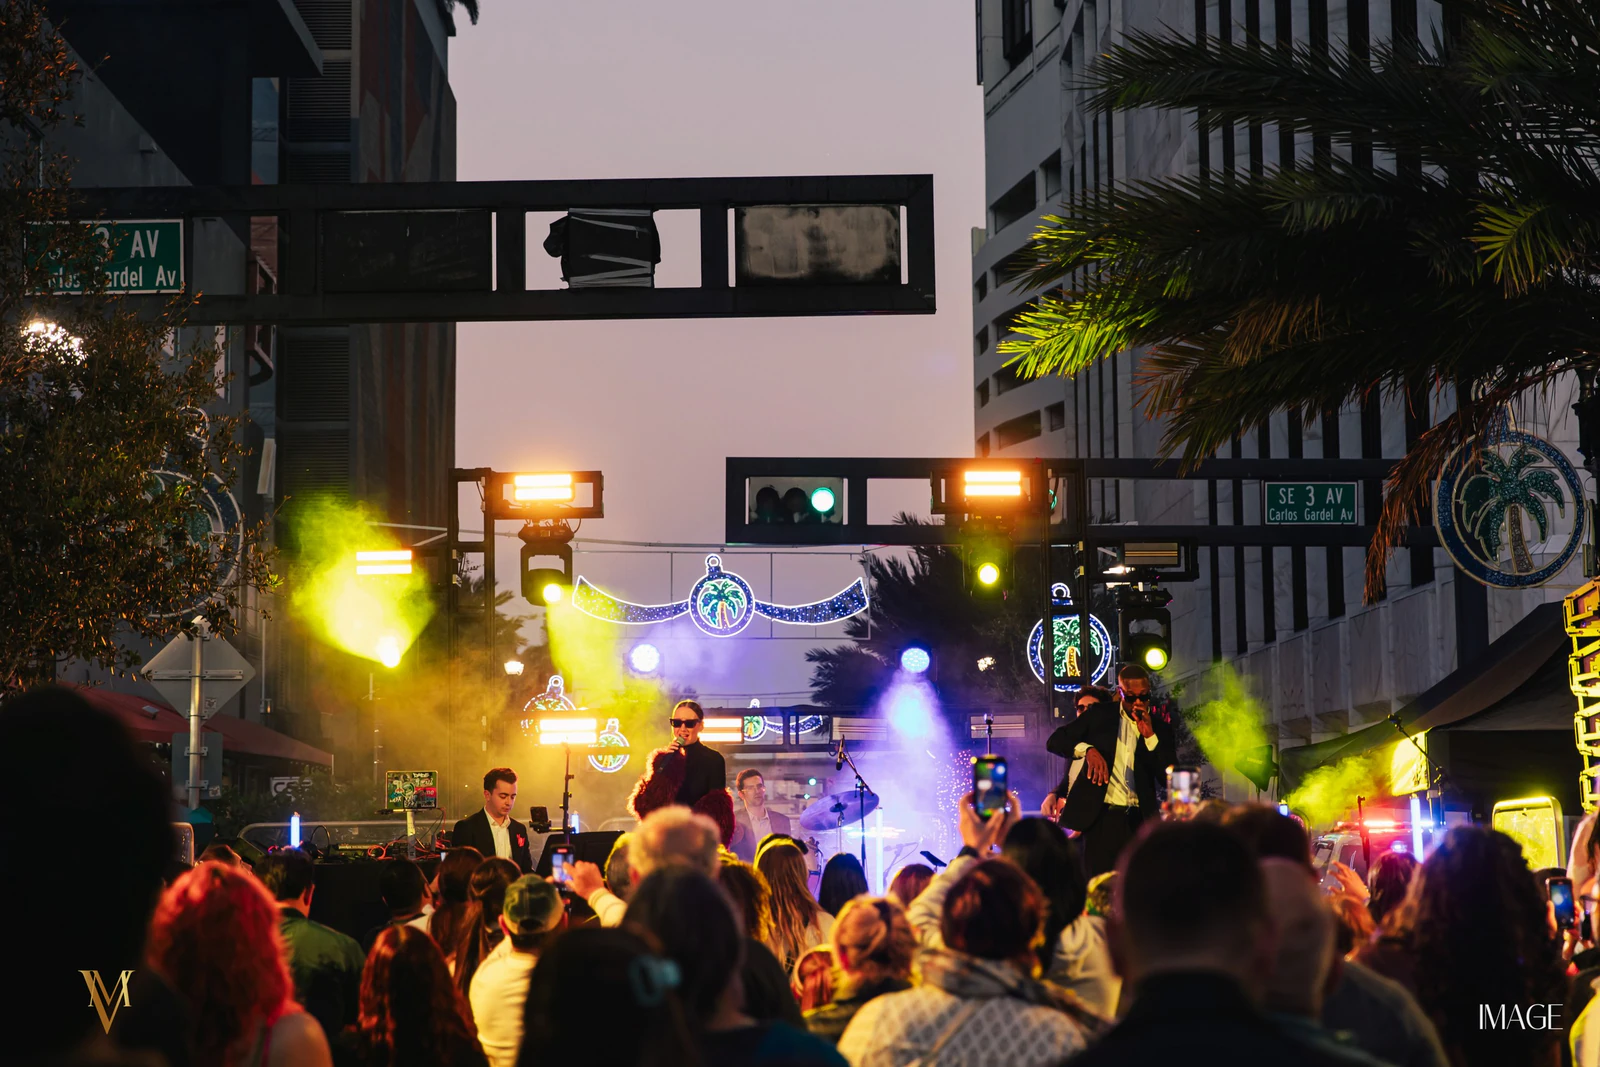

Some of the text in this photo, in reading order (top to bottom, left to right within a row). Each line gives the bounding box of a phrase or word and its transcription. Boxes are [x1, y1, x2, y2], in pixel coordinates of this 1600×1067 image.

[130, 229, 160, 259] AV
[93, 265, 143, 288] ardel
[155, 264, 177, 288] Av
[1278, 485, 1344, 507] SE 3 AV
[1269, 507, 1353, 521] Carlos Gardel Av
